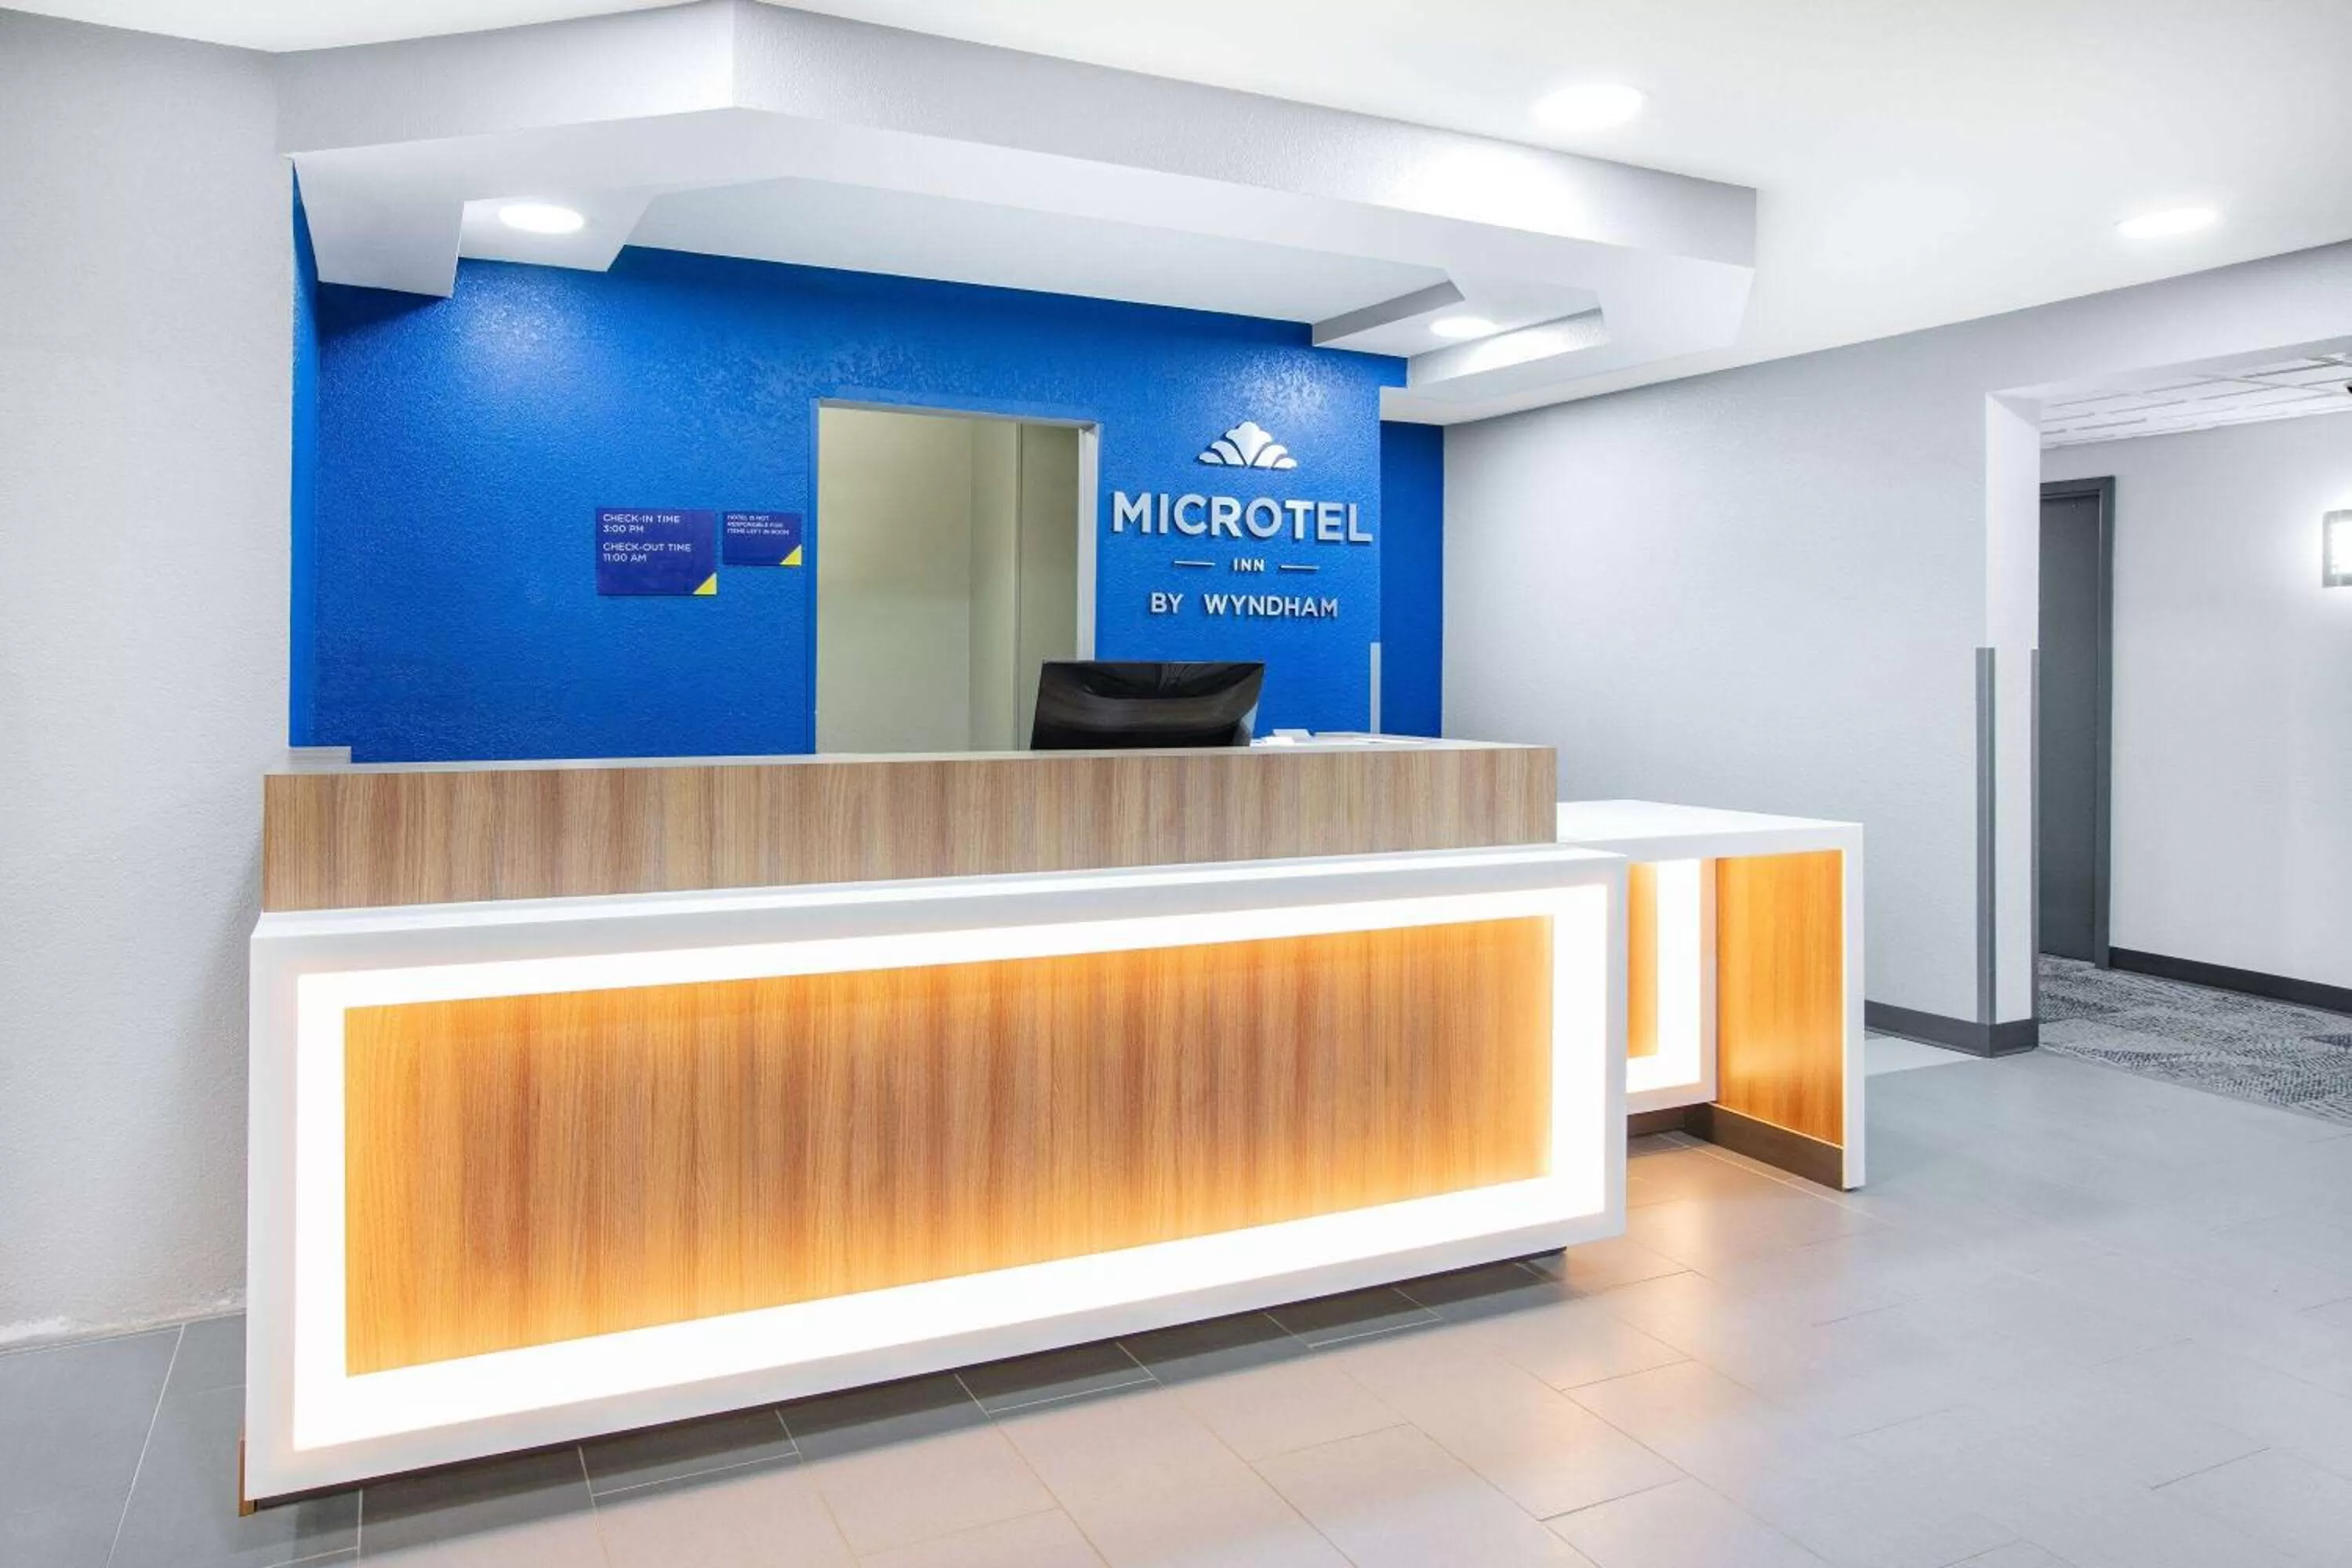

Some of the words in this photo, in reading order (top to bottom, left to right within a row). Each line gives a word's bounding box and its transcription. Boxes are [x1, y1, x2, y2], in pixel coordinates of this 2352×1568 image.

[603, 514, 653, 523] CHECK-IN
[1112, 492, 1373, 542] MICROTEL
[603, 524, 626, 533] 3:00
[629, 524, 644, 533] PM
[603, 543, 665, 551] CHECK-OUT
[668, 543, 691, 552] TIME
[603, 553, 627, 562] 11:00
[630, 554, 647, 562] AM
[1232, 558, 1265, 572] INN
[1150, 592, 1184, 614] BY
[1203, 593, 1338, 618] WYNDHAM
